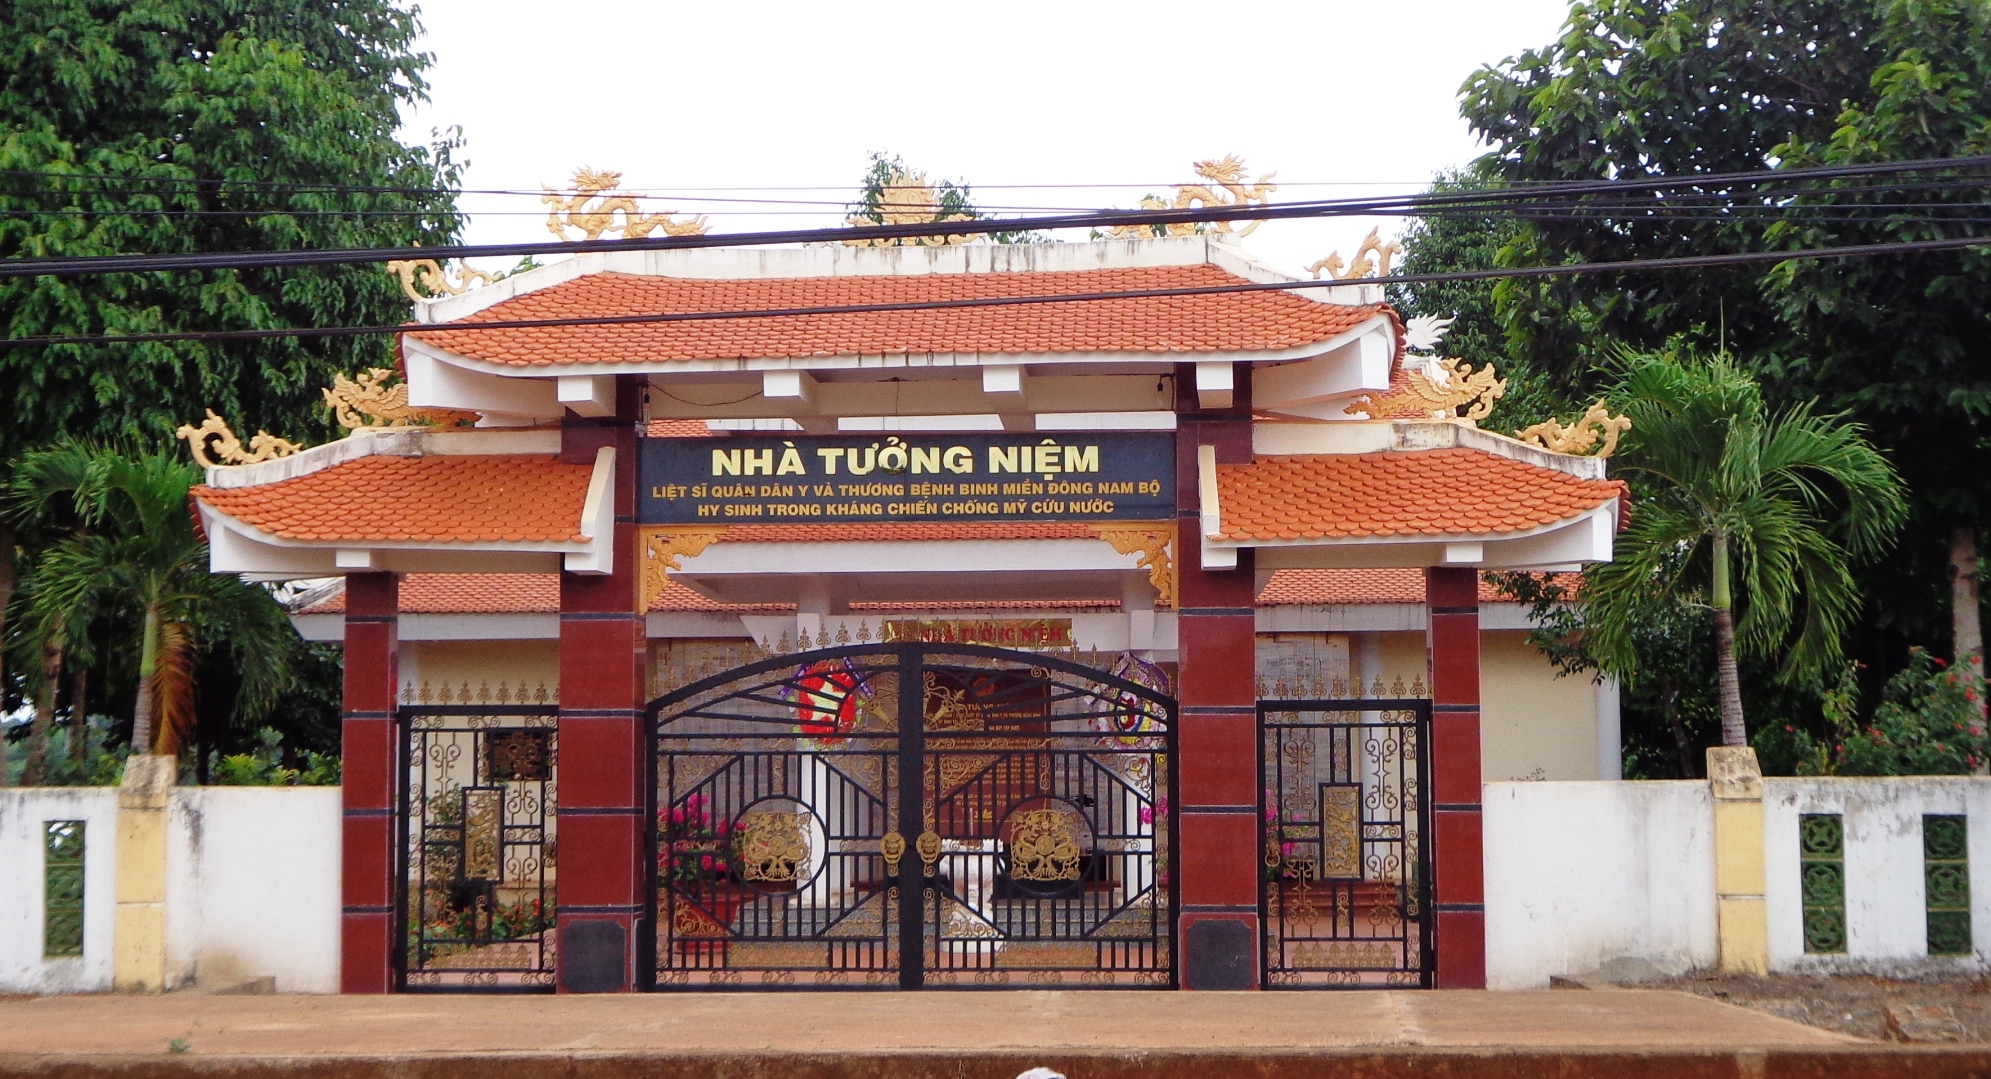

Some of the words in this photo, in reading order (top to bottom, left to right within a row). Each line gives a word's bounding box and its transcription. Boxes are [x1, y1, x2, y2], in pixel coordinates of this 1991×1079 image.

[712, 441, 806, 477] NHÀ
[817, 436, 973, 476] TƯỞNG
[989, 438, 1099, 481] NIỆM
[652, 484, 687, 501] LIỆT
[691, 483, 707, 498] SĨ
[712, 483, 756, 498] QUÂN
[761, 482, 793, 497] DÂN
[798, 485, 809, 497] Y
[814, 482, 834, 497] VÀ
[838, 483, 904, 497] THƯƠNG
[911, 481, 954, 500] BỆNH
[959, 483, 998, 496] BINH
[1003, 478, 1043, 495] MIỀN
[1048, 480, 1093, 495] ĐÔNG
[1098, 482, 1133, 494] NAM
[1138, 480, 1161, 497] BỘ
[697, 504, 719, 516] HY
[724, 504, 762, 516] SINH
[767, 503, 821, 516] TRONG
[826, 501, 882, 516] KHÁNG
[887, 500, 937, 515] CHIẾN
[942, 499, 998, 514] CHỐNG
[1003, 498, 1028, 514] MỸ
[1031, 498, 1064, 513] CỨU
[1070, 498, 1114, 513] NƯỚC
